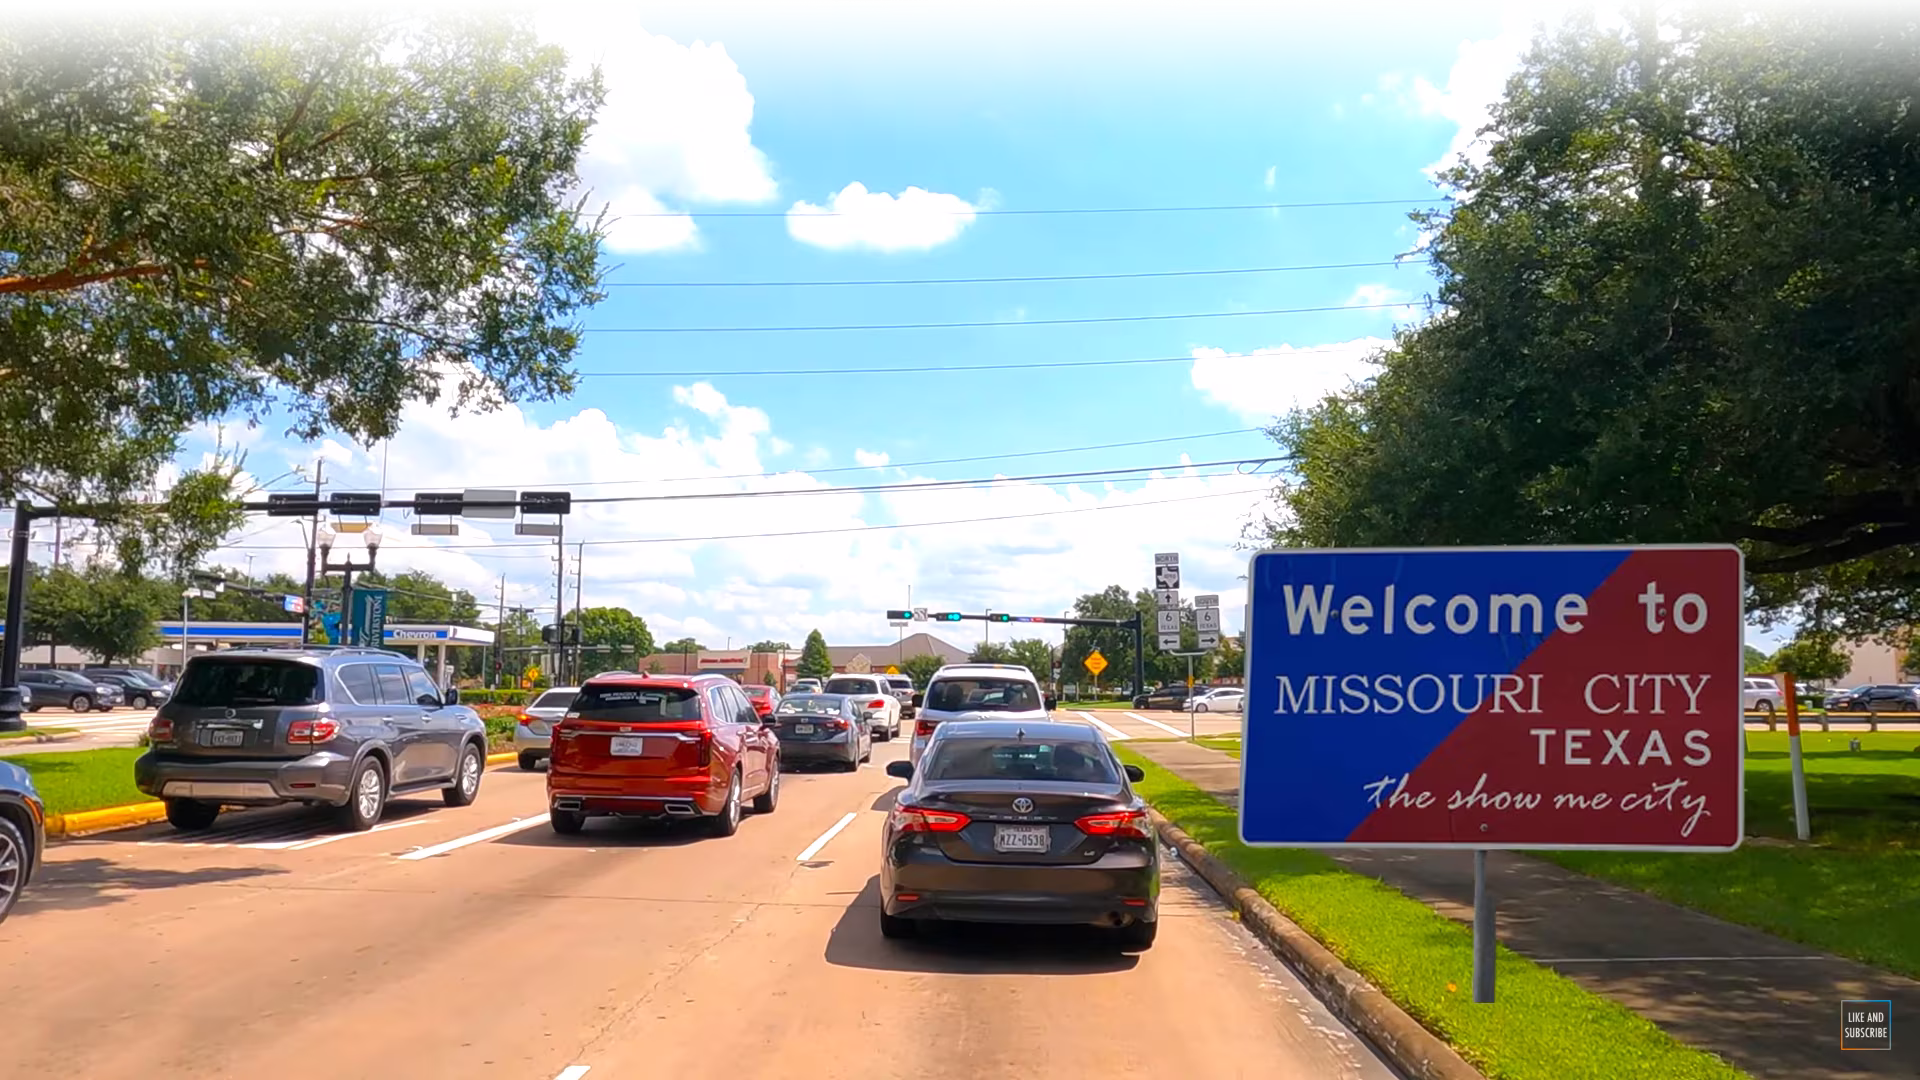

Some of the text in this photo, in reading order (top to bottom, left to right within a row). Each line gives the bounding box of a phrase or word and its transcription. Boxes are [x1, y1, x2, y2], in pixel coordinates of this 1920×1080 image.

[1165, 612, 1173, 622] 6
[1204, 611, 1212, 622] 6
[1282, 580, 1709, 635] Welcome to
[393, 629, 437, 639] Chevron
[1273, 673, 1712, 715] MISSOURI CITY
[1529, 728, 1713, 767] TEXAS
[1362, 772, 1712, 838] the show me city
